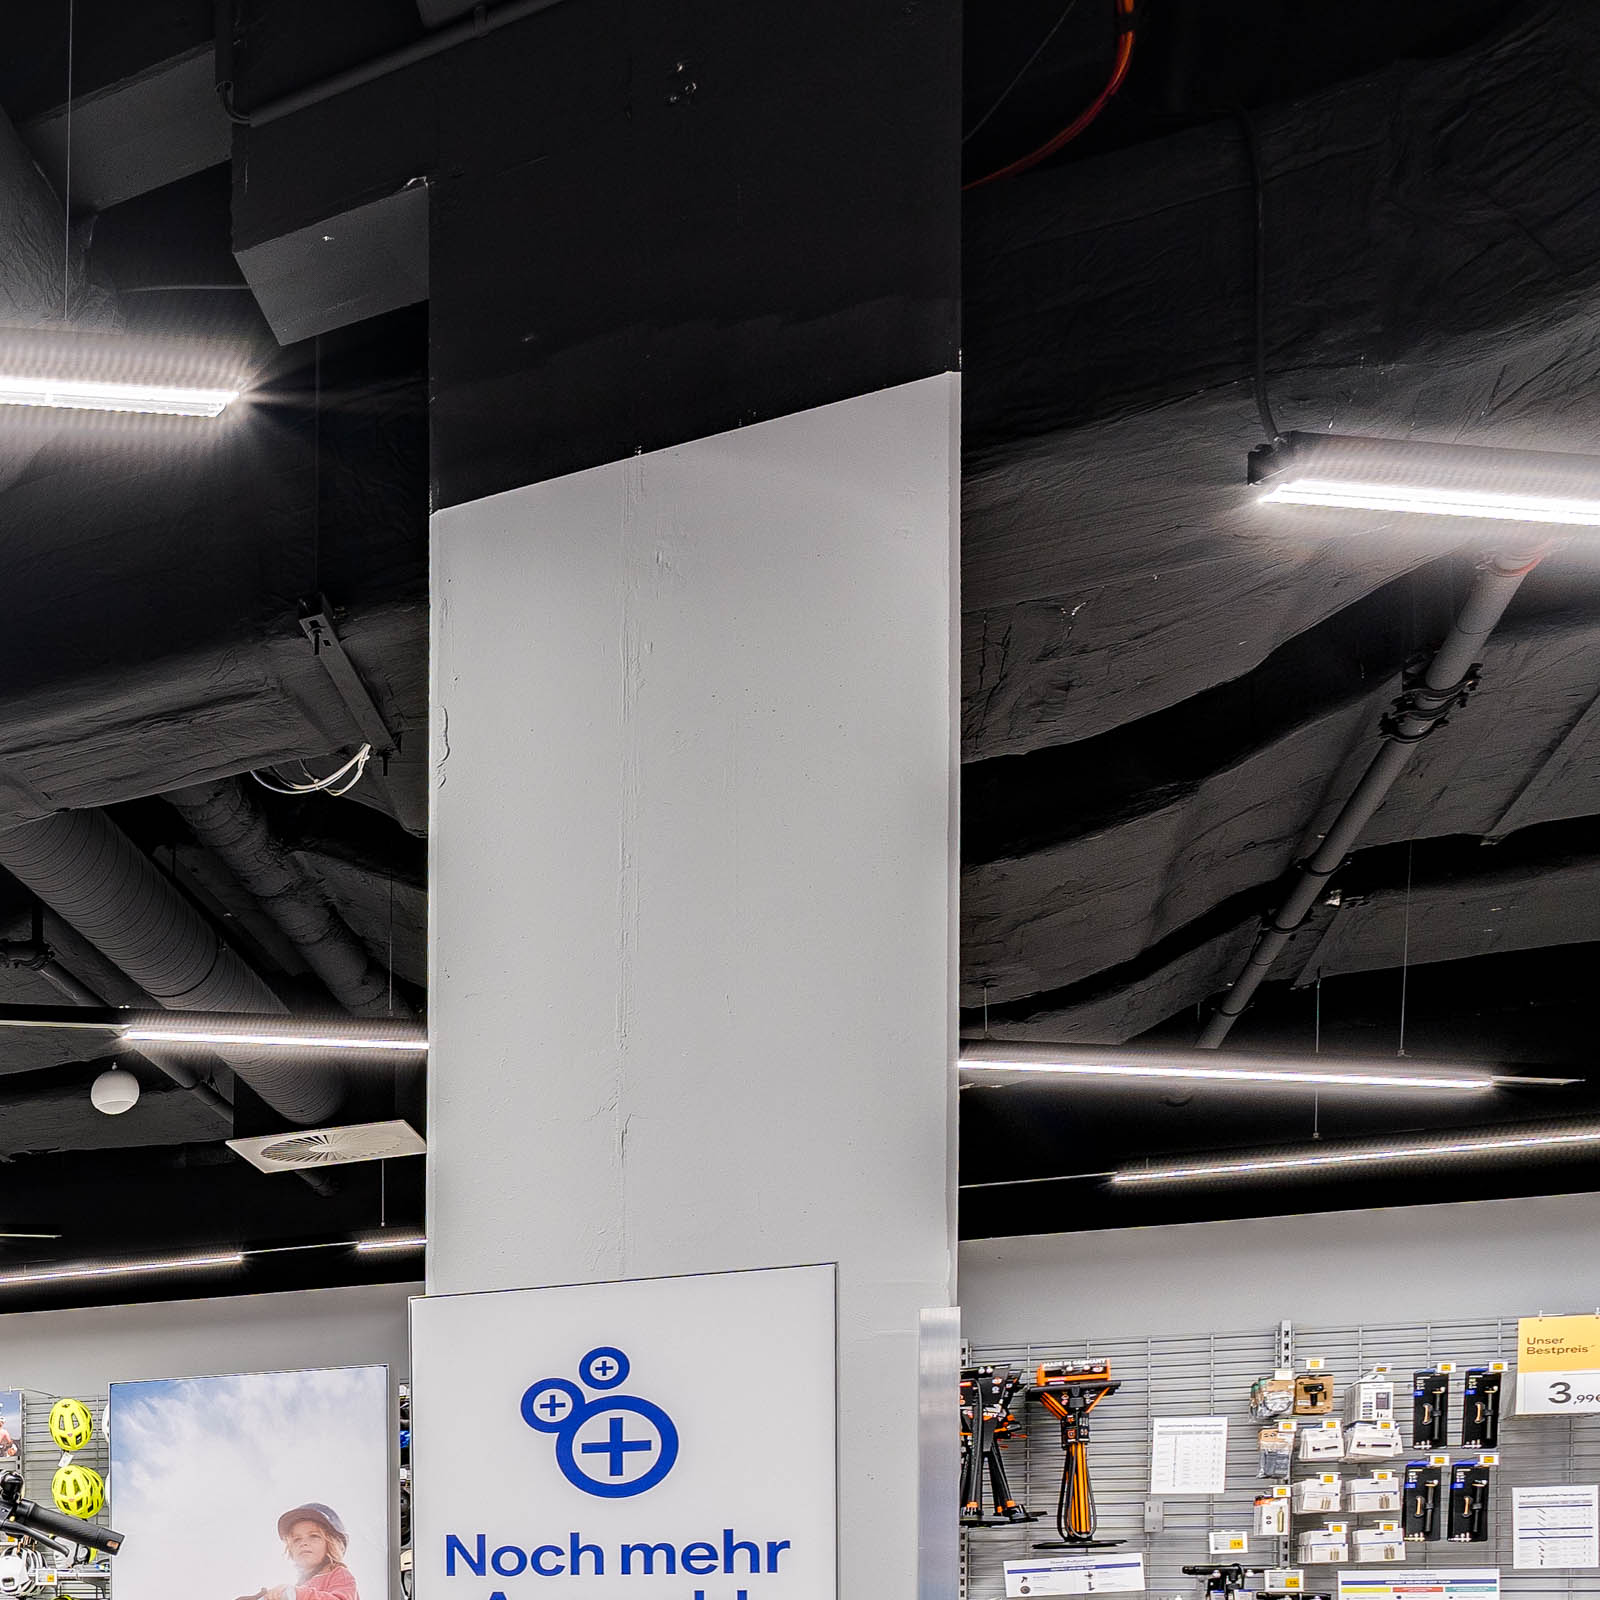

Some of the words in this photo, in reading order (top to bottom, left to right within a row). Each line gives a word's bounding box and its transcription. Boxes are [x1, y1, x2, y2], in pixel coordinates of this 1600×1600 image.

[1527, 1337, 1565, 1346] Unser
[445, 1532, 605, 1577] Noch
[621, 1529, 790, 1576] mehr
